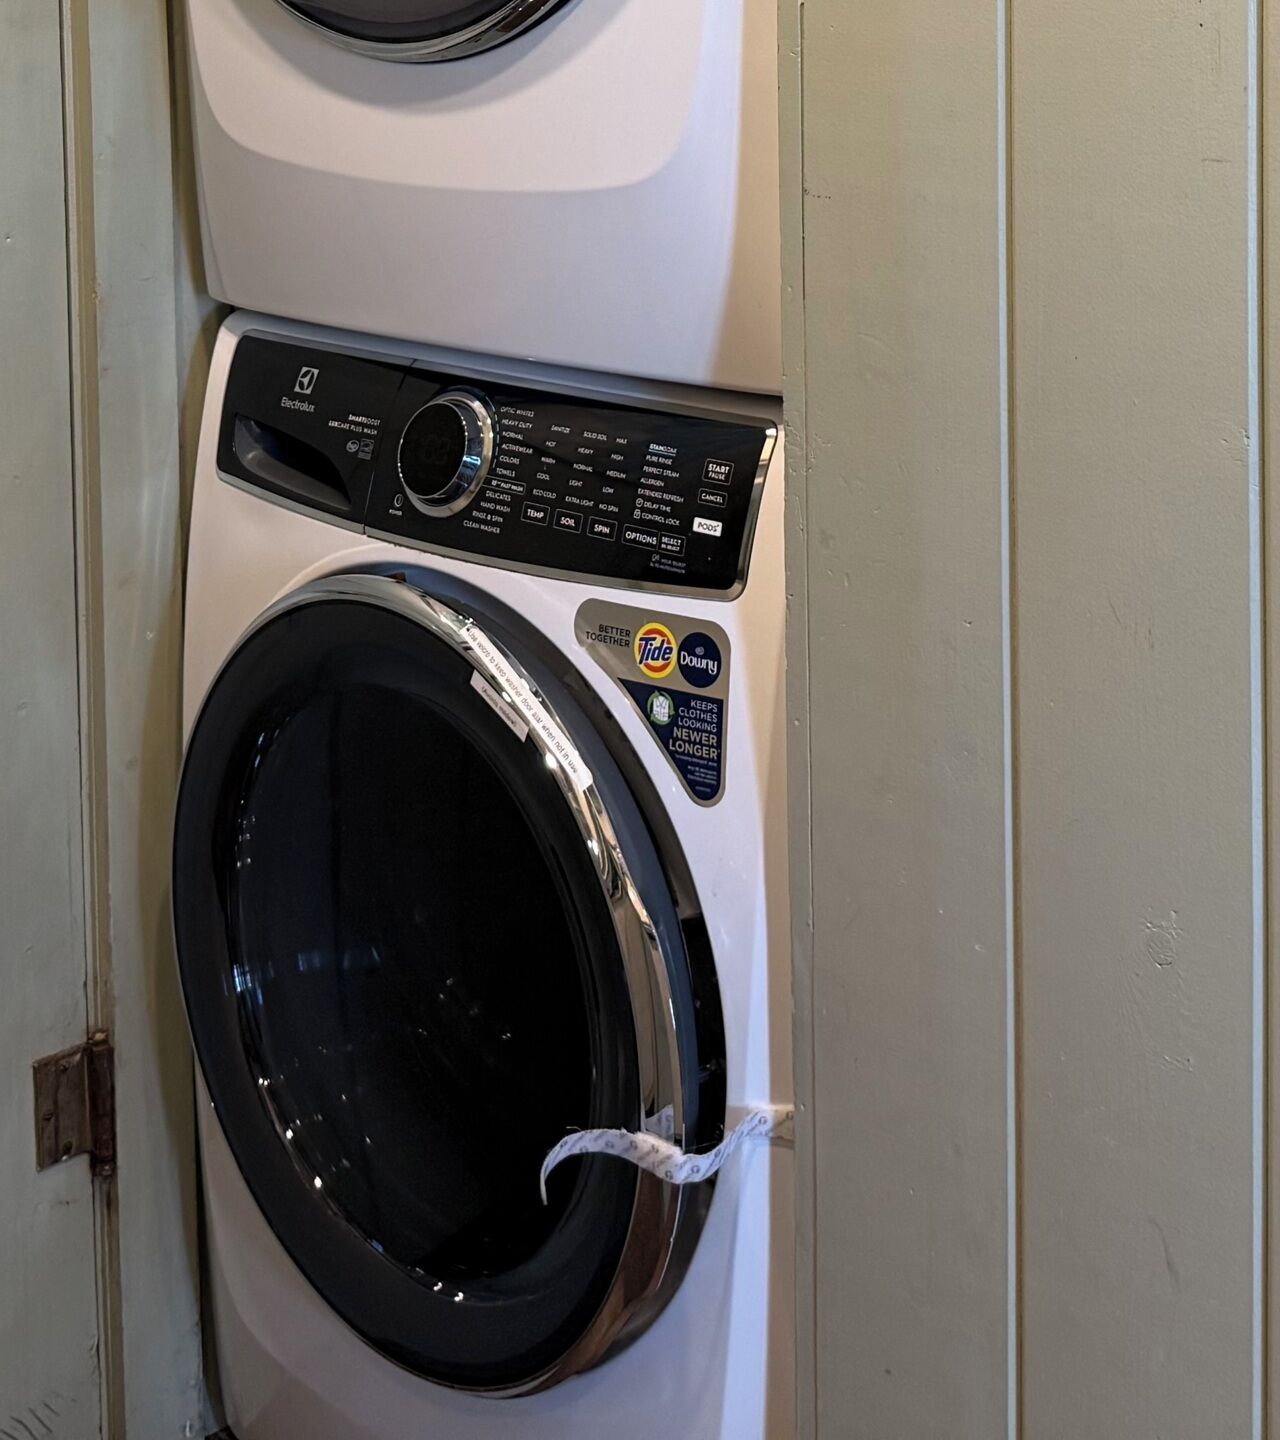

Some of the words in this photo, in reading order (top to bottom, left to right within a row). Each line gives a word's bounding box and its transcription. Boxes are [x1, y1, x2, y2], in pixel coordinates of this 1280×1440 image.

[281, 396, 315, 412] Electrolux
[707, 463, 730, 474] START
[708, 471, 726, 481] PAUSE
[701, 492, 723, 503] CANCEL
[527, 508, 545, 519] TEMP
[641, 512, 665, 524] CONTROL
[666, 517, 680, 527] LOCK
[560, 516, 576, 527] SOIL
[594, 524, 610, 535] SPIN
[625, 531, 657, 545] OPTIONS
[661, 536, 682, 546] SELECT
[598, 623, 631, 638] BETTER
[585, 631, 631, 648] TOGETHER
[638, 635, 675, 666] Tide
[680, 651, 718, 676] Downy
[690, 699, 718, 712] KEEPS
[505, 676, 523, 699] washer
[521, 696, 534, 715] door
[541, 722, 556, 744] when
[554, 741, 566, 755] not
[678, 707, 718, 723] CLOTHES
[678, 717, 718, 733] LOOKING
[673, 726, 718, 746] NEWER
